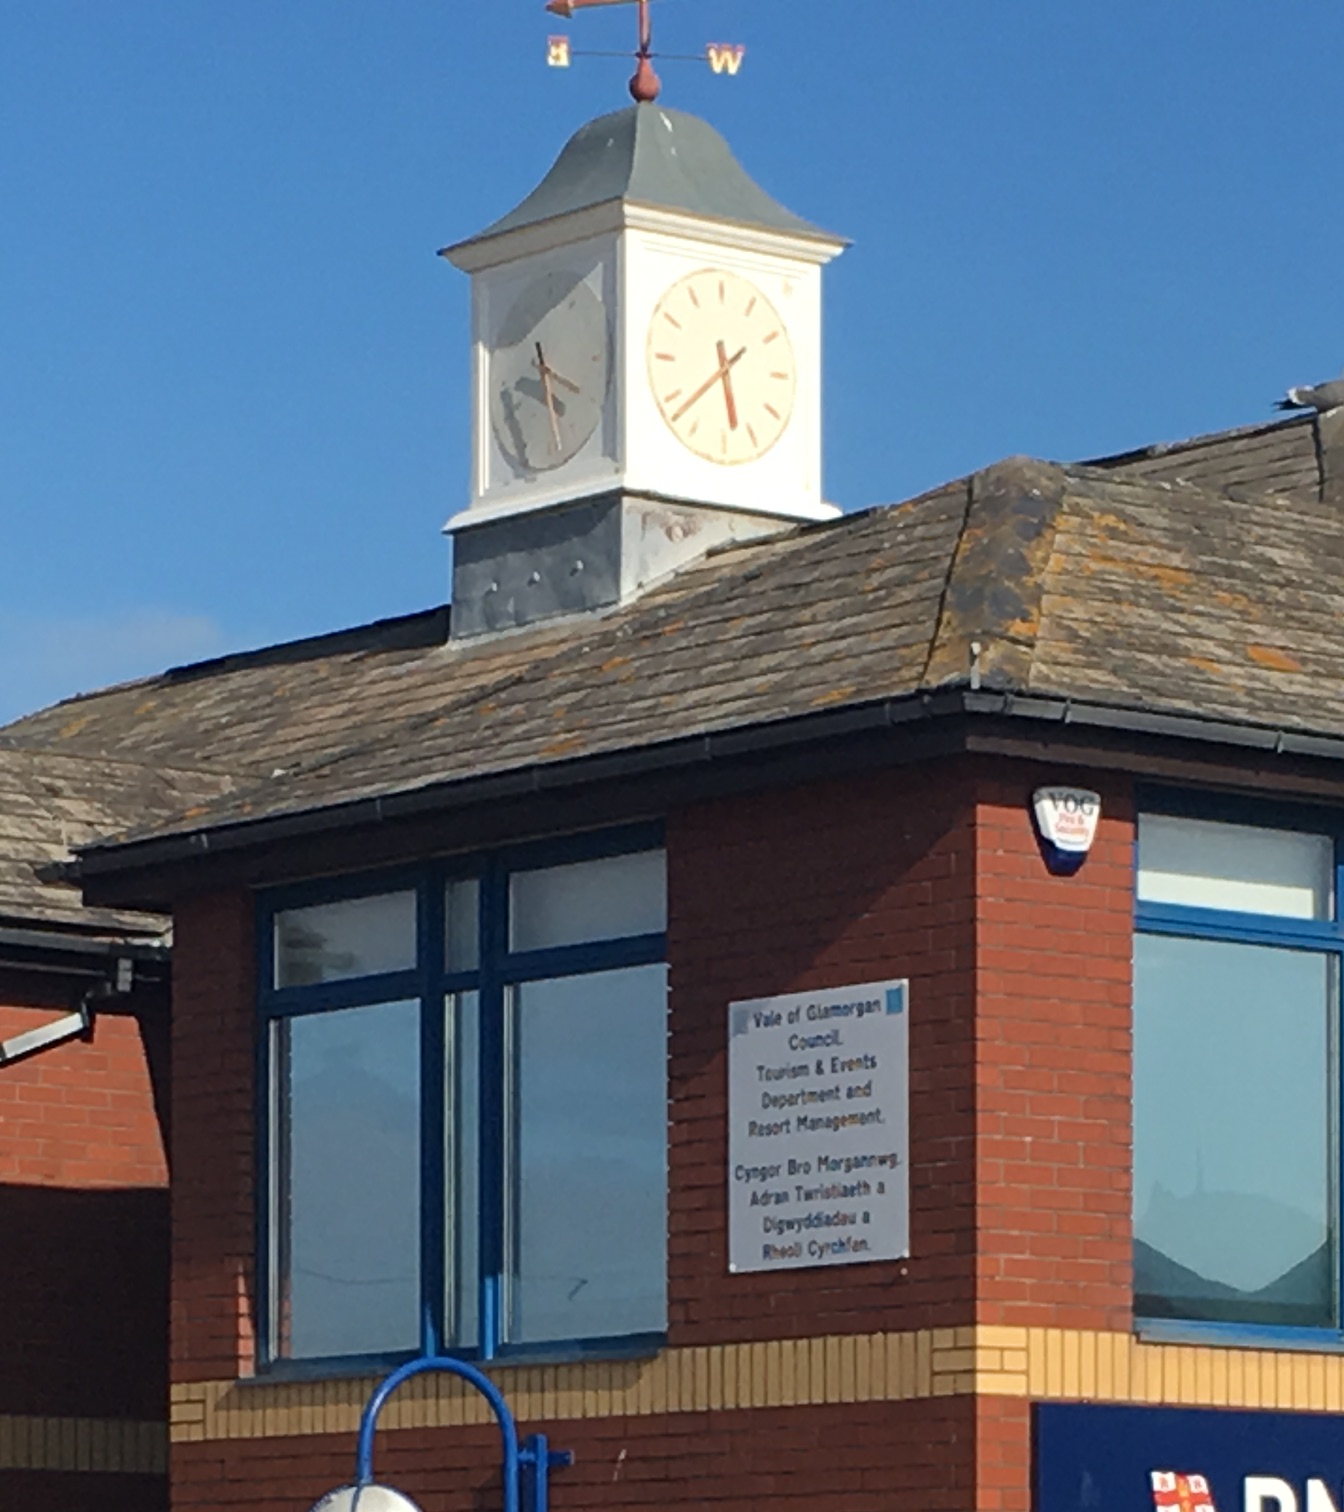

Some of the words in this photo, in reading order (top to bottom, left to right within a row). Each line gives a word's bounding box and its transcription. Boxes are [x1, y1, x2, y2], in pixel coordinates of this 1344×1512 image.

[754, 1010, 782, 1028] Vale
[788, 1005, 801, 1025] of
[806, 999, 882, 1021] Glamorgan
[757, 1061, 810, 1082] Tourism
[815, 1059, 825, 1076] &
[831, 1054, 878, 1074] Events
[761, 1084, 842, 1110] Department
[846, 1079, 873, 1100] and
[748, 1114, 792, 1139] Resort
[787, 1159, 812, 1176] Bro
[876, 1181, 886, 1195] a
[862, 1211, 871, 1225] a
